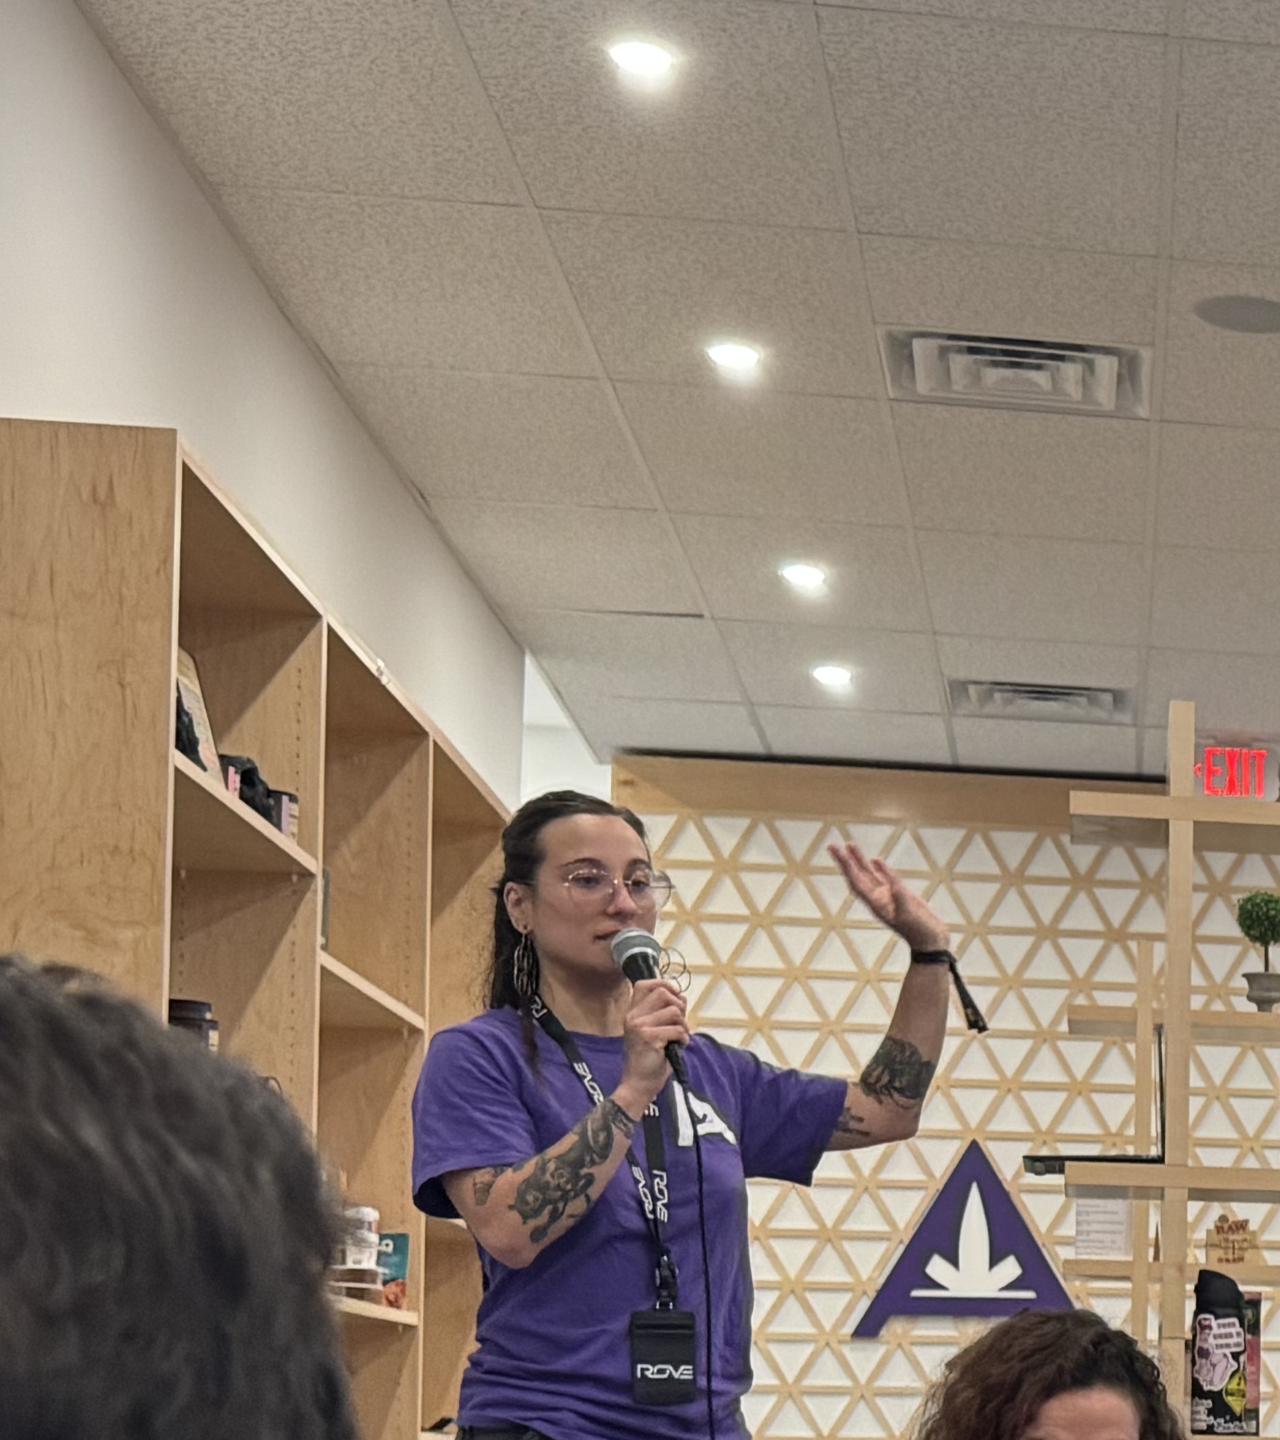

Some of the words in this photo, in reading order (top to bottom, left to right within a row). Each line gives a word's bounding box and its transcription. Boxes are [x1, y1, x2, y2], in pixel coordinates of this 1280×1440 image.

[1203, 747, 1268, 799] EXIT
[632, 1166, 655, 1219] ROVE
[652, 1169, 668, 1223] ROVE
[1215, 1218, 1250, 1236] RAW
[636, 1363, 694, 1380] ROVE
